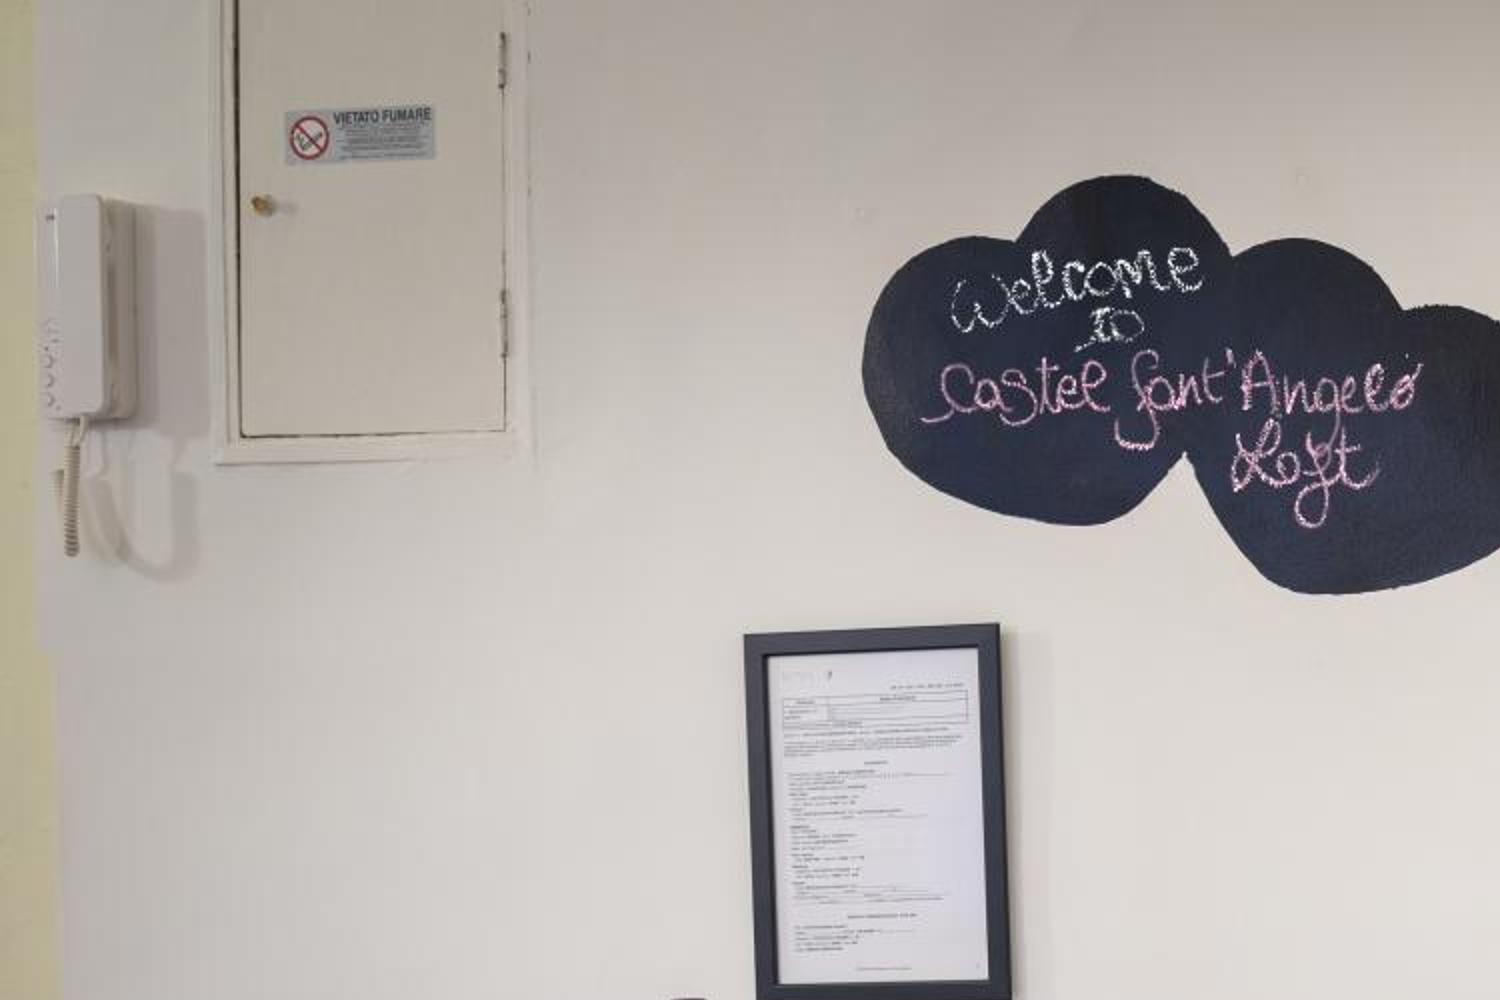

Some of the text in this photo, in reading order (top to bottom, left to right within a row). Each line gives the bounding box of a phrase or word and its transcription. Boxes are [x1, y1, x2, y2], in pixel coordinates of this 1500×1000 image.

[333, 107, 431, 124] VIETATO FUMARE
[950, 246, 1203, 333] Welcome
[1230, 415, 1382, 530] Loft
